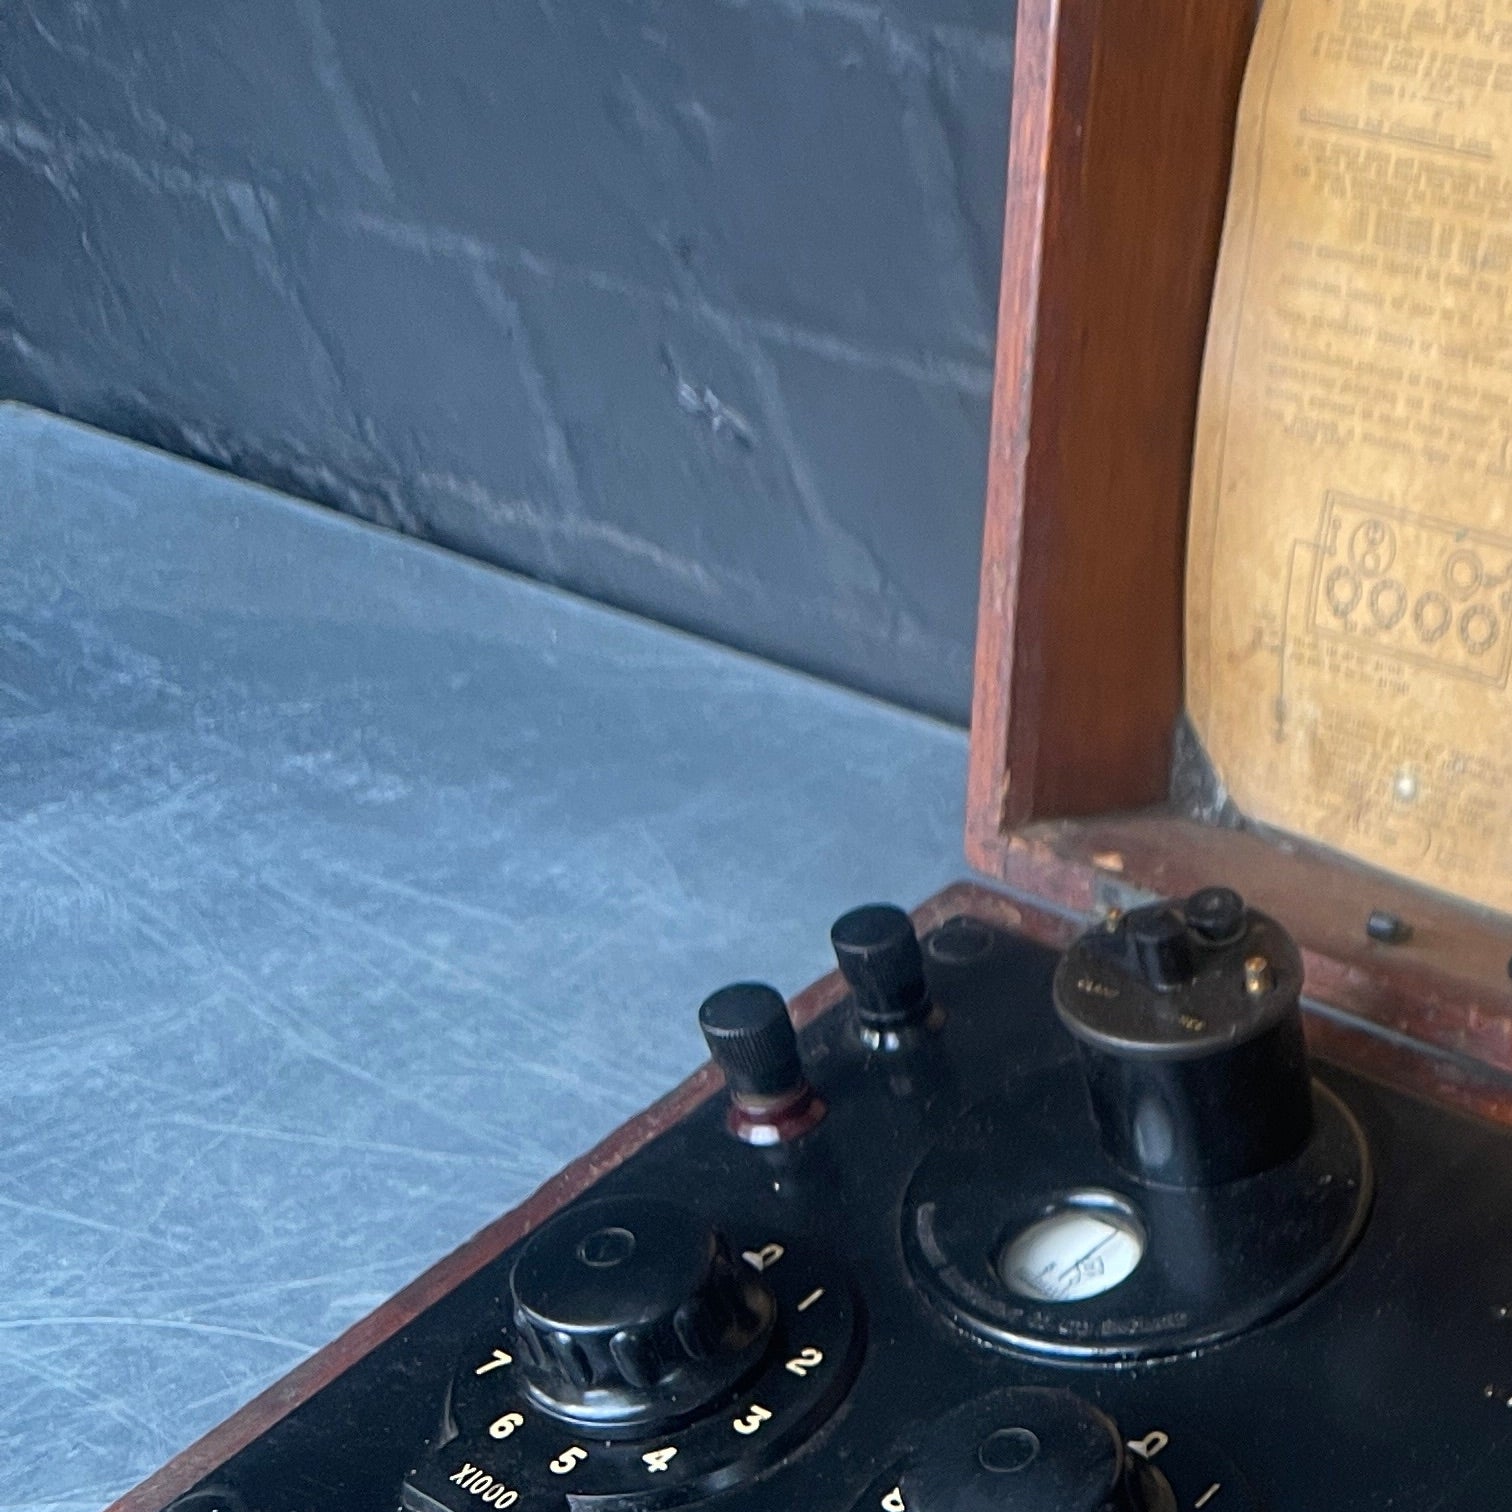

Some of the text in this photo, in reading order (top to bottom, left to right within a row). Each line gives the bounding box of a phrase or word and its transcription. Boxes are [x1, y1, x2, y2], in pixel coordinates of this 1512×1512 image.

[798, 1287, 824, 1312] 1
[475, 1349, 513, 1375] 7
[786, 1347, 823, 1376] 2
[489, 1412, 524, 1438] 6
[733, 1404, 772, 1434] 3
[550, 1446, 588, 1474] 5
[642, 1446, 677, 1472] 4
[448, 1463, 519, 1511] X1000
[1195, 1483, 1221, 1508] 1
